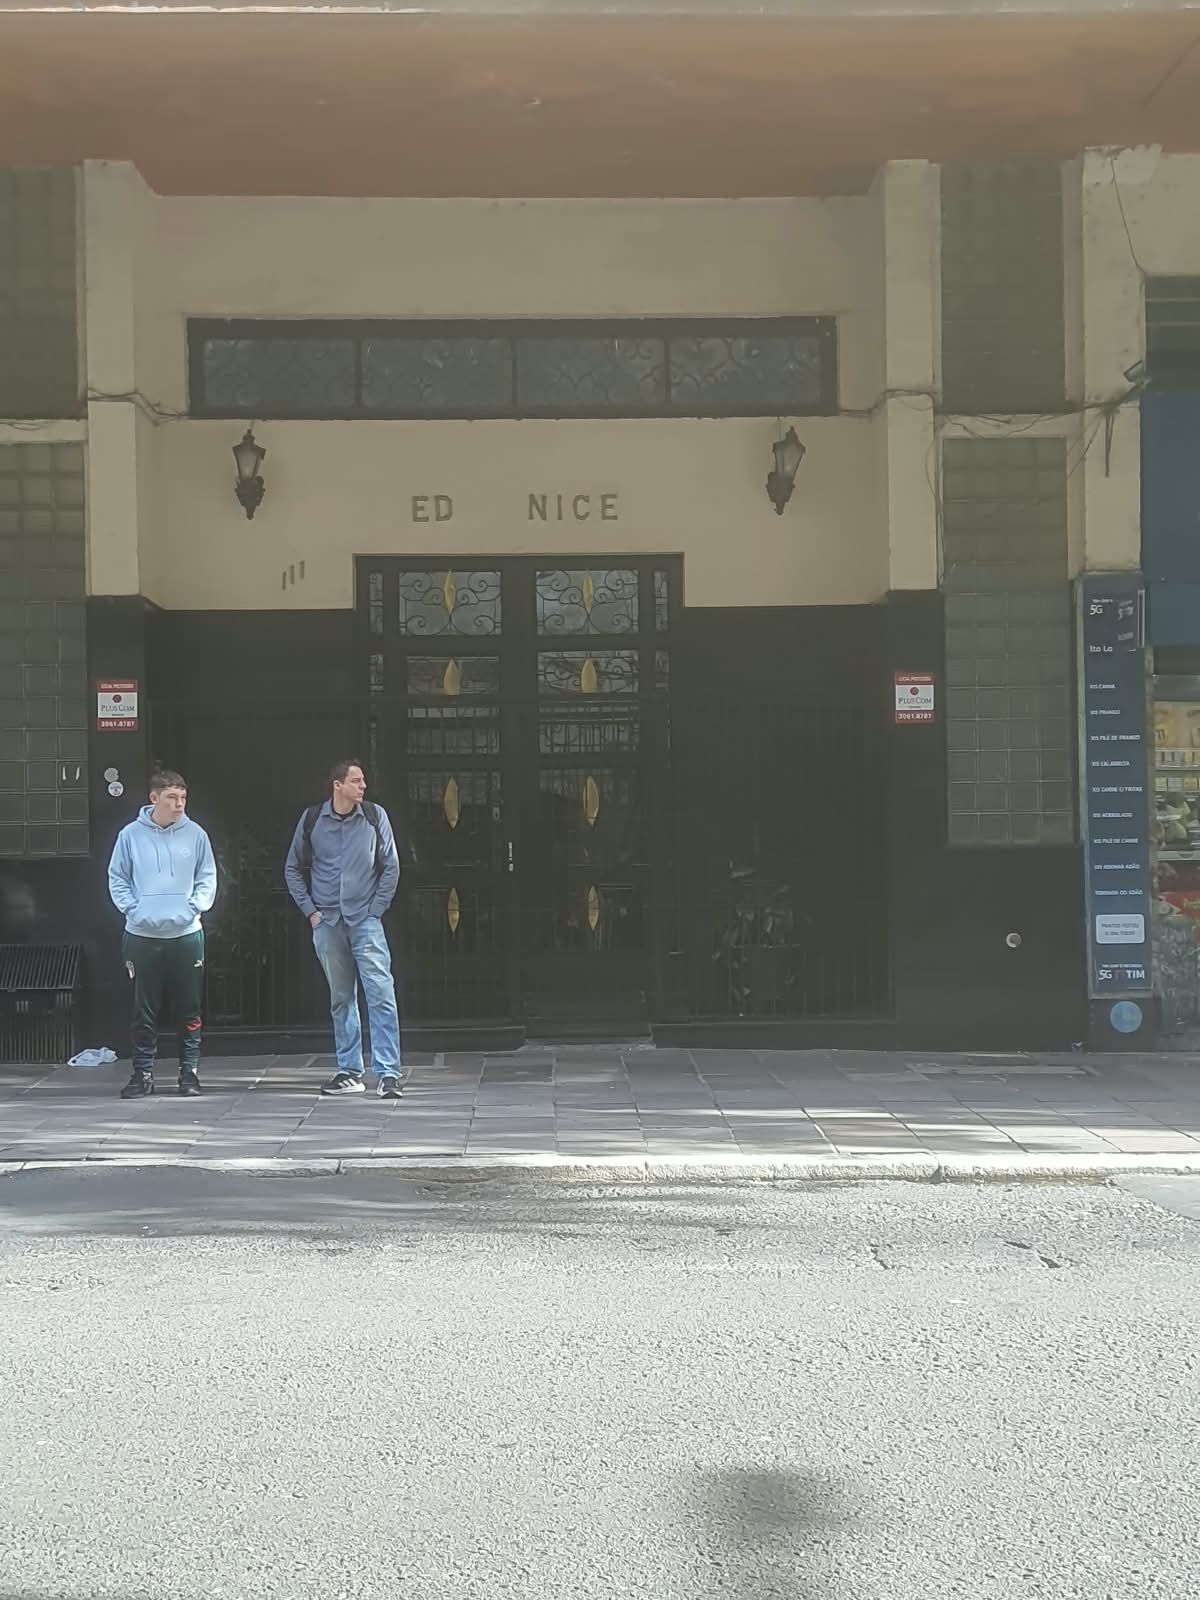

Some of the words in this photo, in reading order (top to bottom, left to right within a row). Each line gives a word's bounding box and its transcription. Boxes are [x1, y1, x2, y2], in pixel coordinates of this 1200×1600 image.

[411, 494, 453, 522] ED
[528, 493, 619, 521] NICE
[1089, 604, 1103, 615] 5G
[1098, 969, 1113, 981] 5G
[1126, 969, 1145, 980] TIM
